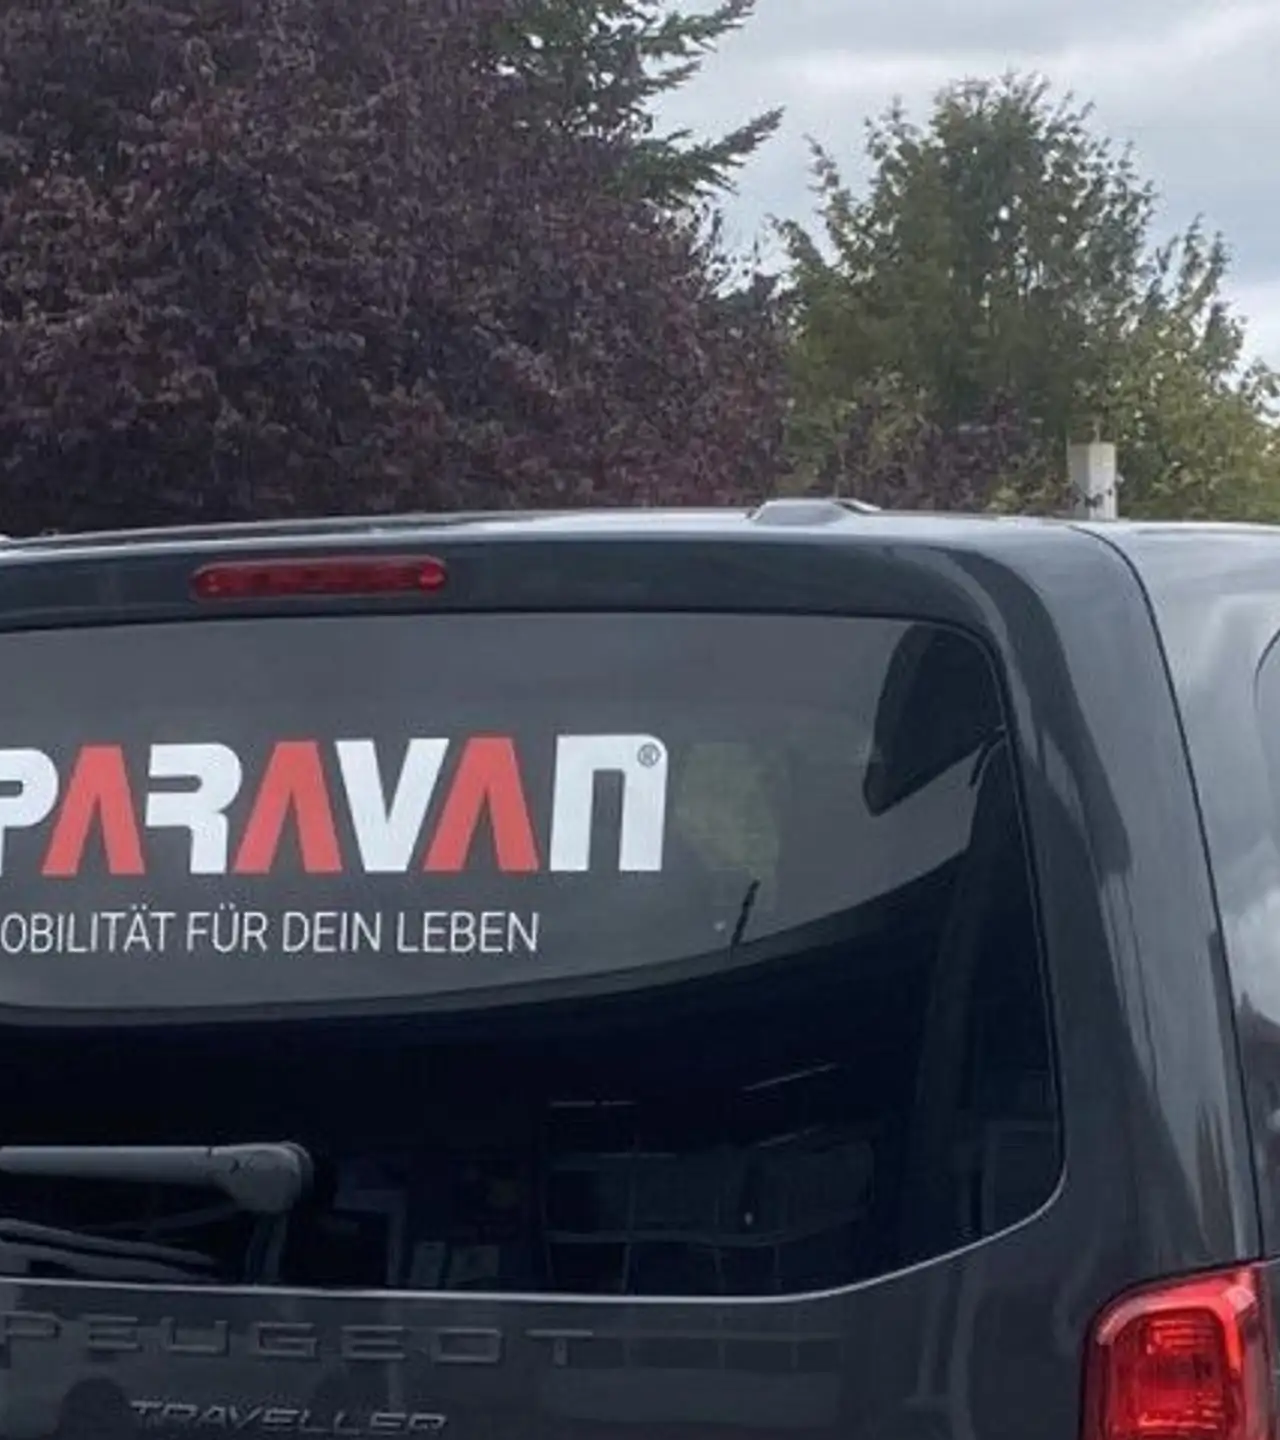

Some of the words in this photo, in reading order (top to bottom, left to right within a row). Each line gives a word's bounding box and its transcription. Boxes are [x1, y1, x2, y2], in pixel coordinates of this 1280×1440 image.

[187, 903, 269, 953] FÜR
[282, 911, 384, 953] DEIN
[397, 911, 540, 953] LEBEN
[129, 1399, 449, 1436] TRAVELLER
